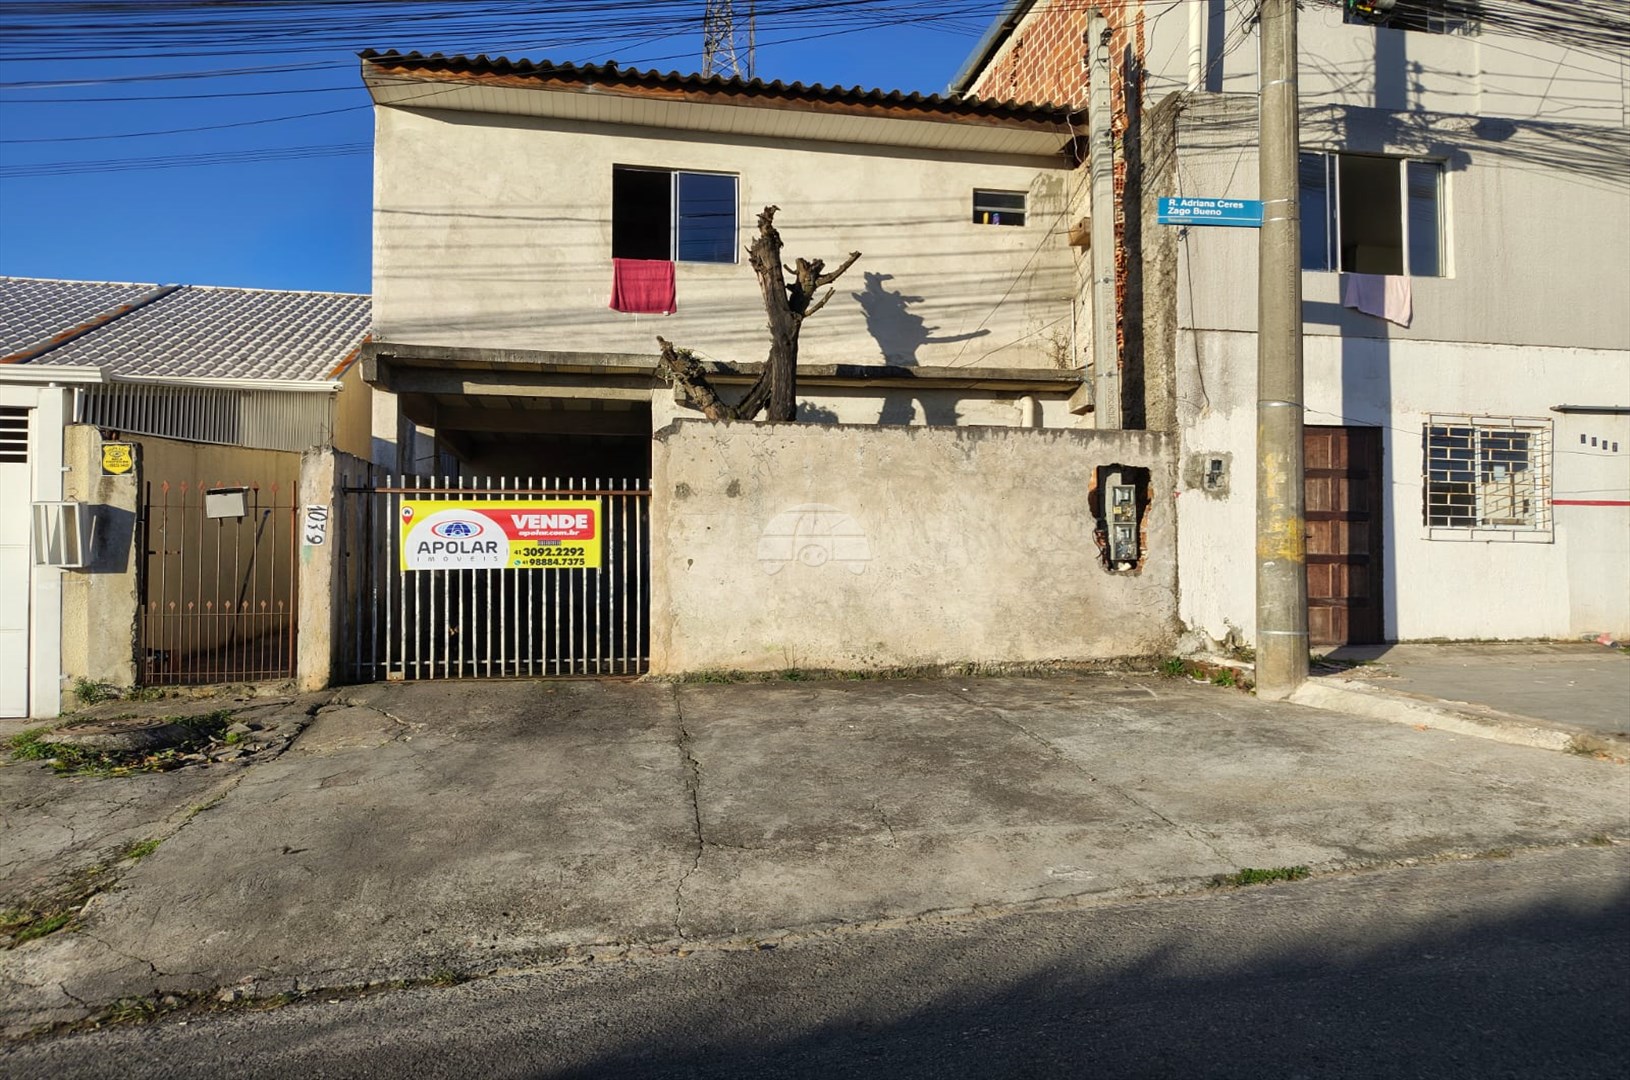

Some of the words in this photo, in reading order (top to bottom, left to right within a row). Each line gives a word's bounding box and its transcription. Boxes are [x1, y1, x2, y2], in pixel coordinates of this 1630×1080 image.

[1168, 199, 1178, 207] R.
[1180, 199, 1215, 208] Adriana
[1217, 200, 1244, 209] Ceres
[1167, 207, 1191, 216] Zago
[1193, 207, 1222, 216] Bueno
[306, 505, 328, 545] 1039
[510, 514, 588, 530] VENDE
[518, 529, 580, 537] apolar.com.br
[417, 541, 498, 555] APOLAR
[523, 547, 585, 557] 3092.2292
[529, 558, 585, 566] 98884.7375
